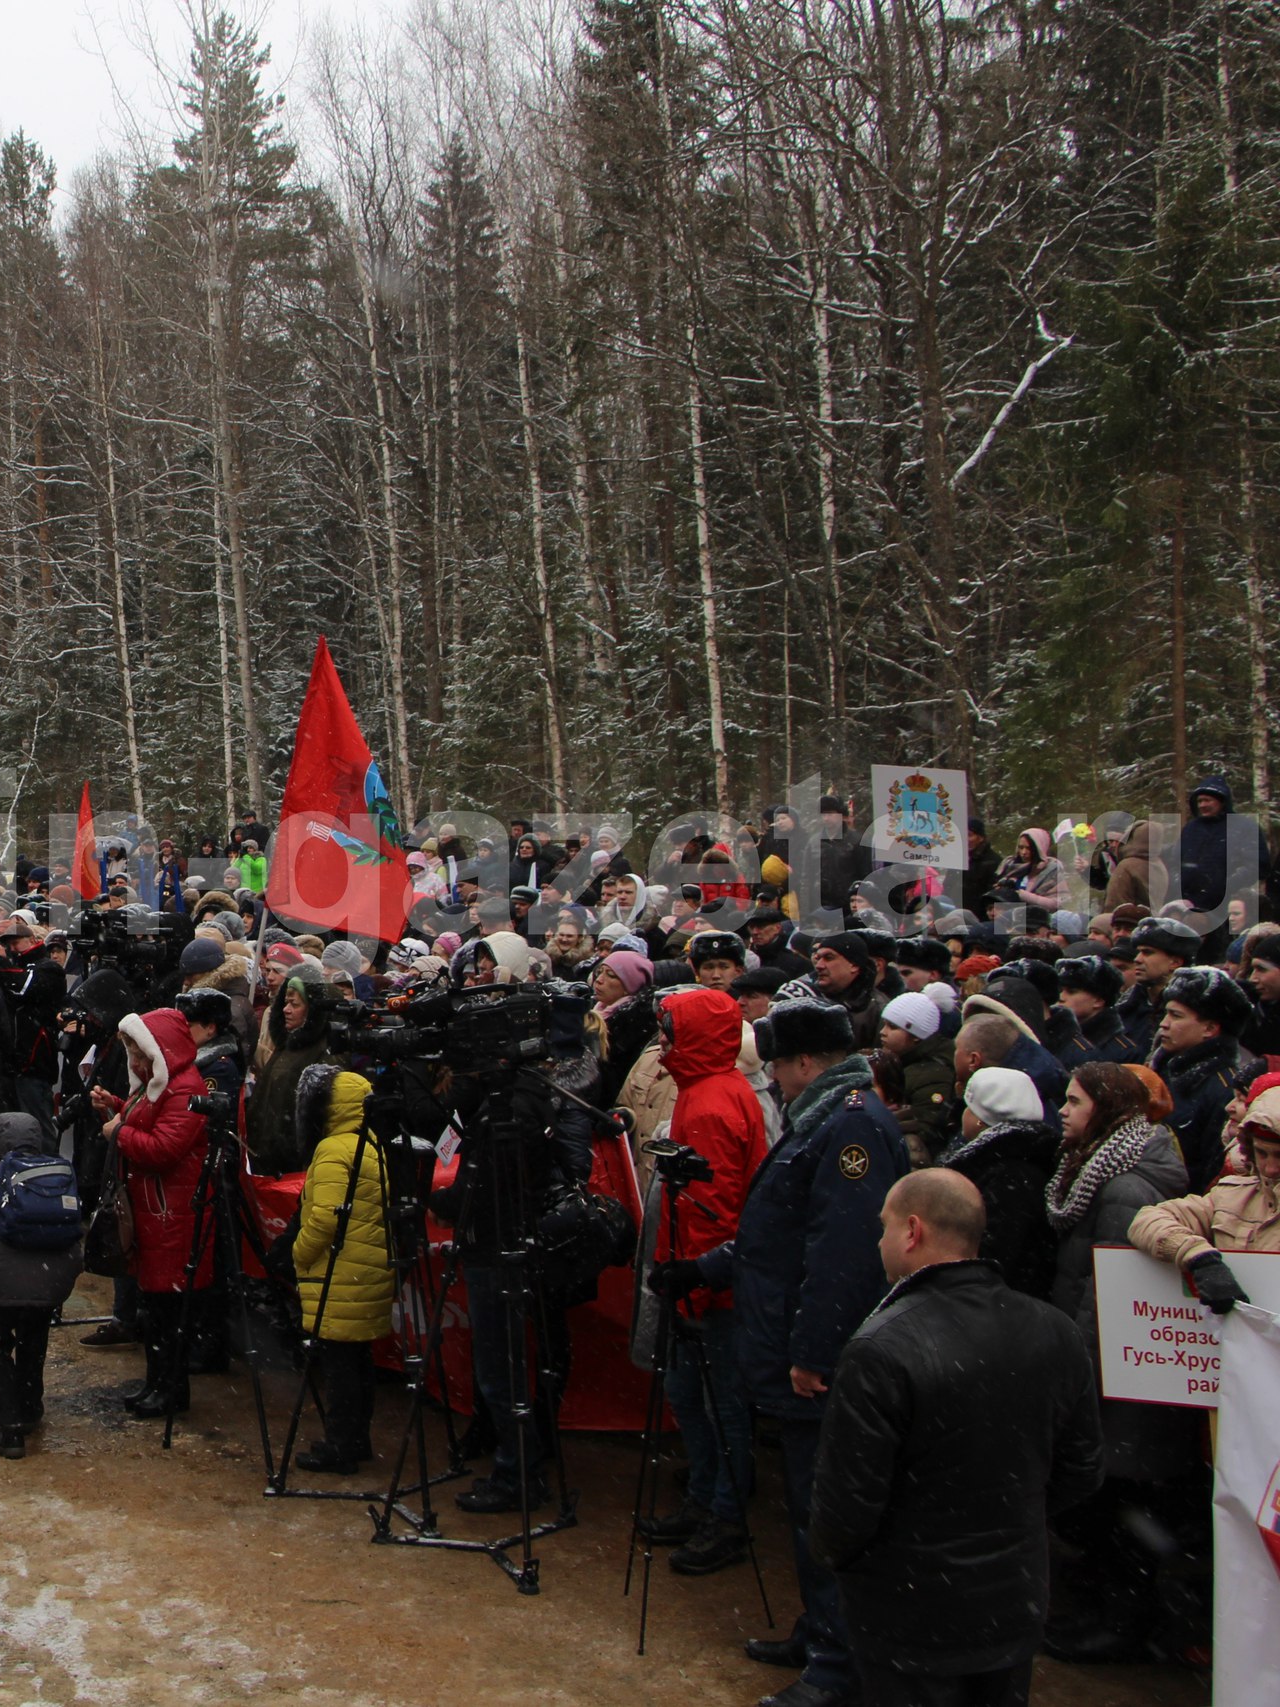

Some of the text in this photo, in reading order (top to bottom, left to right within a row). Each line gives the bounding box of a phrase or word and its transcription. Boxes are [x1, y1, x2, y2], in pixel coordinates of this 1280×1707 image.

[903, 850, 940, 864] Самара
[1133, 1300, 1203, 1323] Муниц
[1123, 1346, 1221, 1372] Гусь-Хрус
